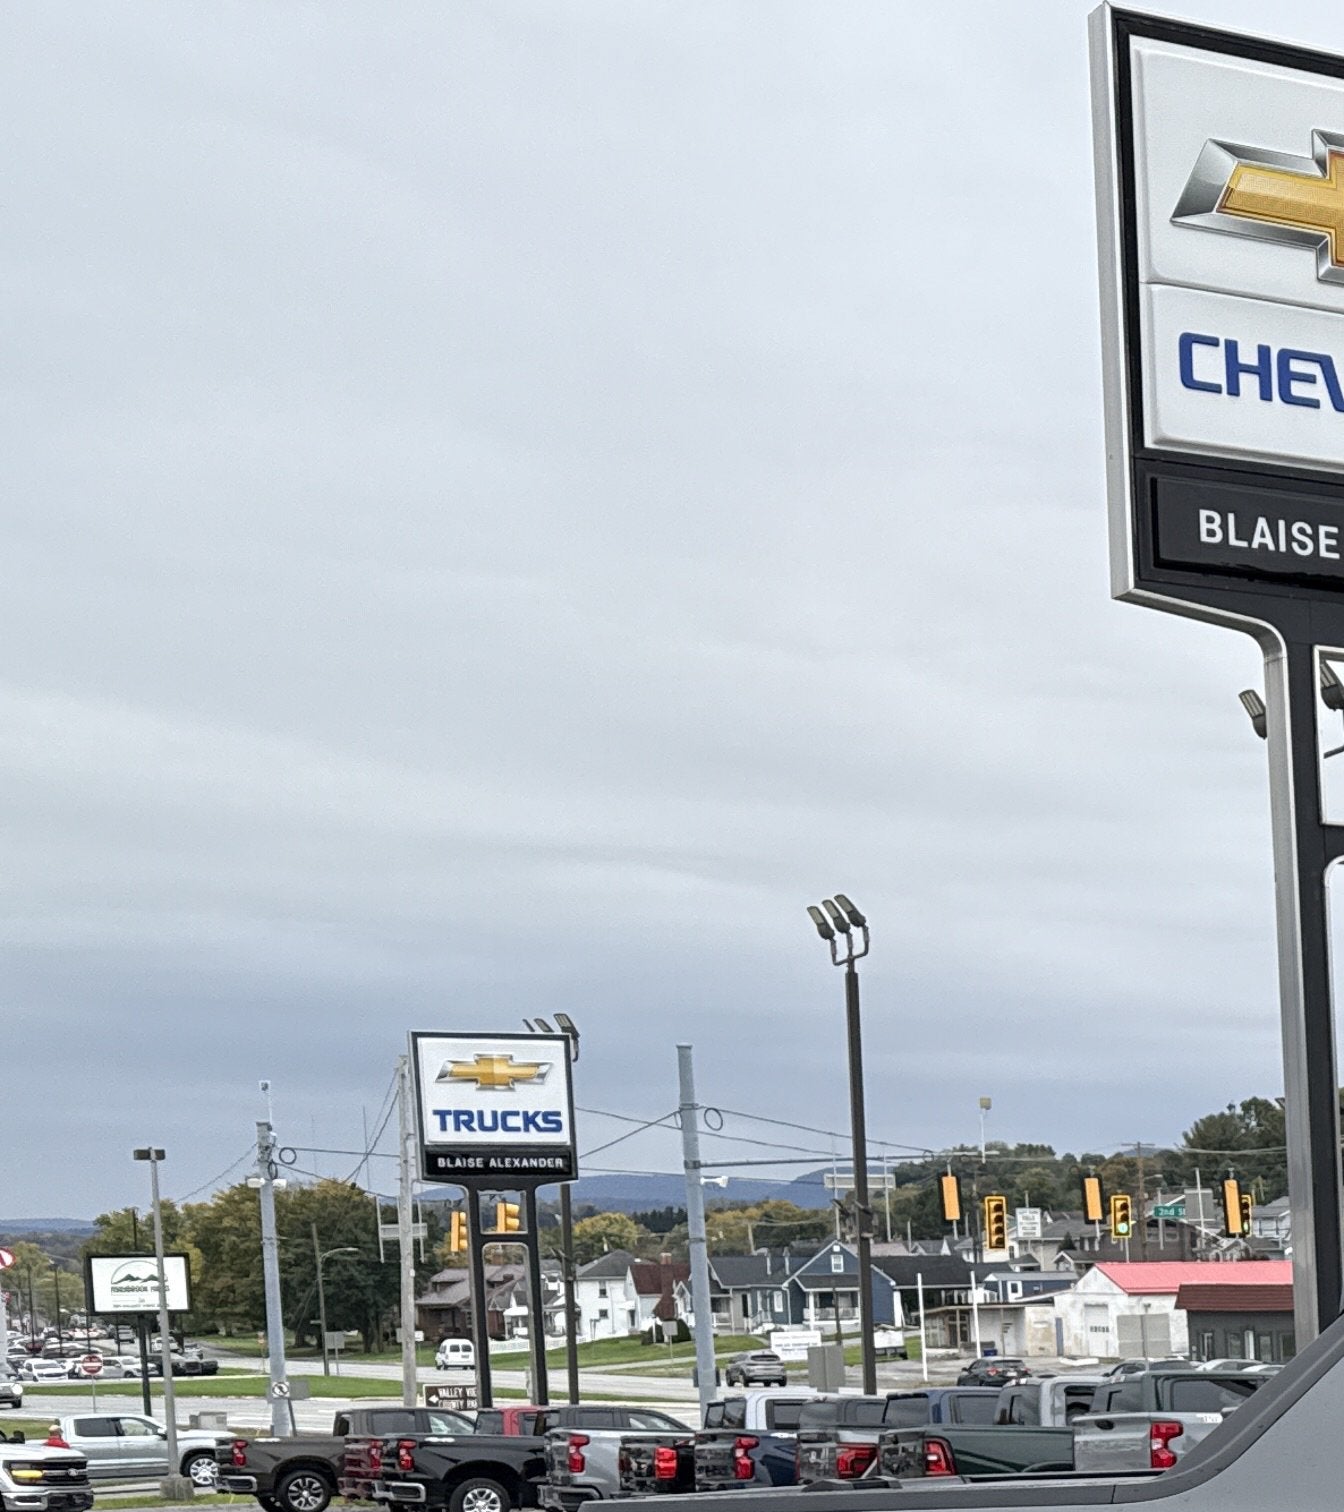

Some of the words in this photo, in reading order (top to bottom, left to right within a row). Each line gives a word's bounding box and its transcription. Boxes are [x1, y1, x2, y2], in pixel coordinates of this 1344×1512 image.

[1199, 510, 1341, 561] BLAISE
[433, 1109, 563, 1132] TRUCKS
[437, 1157, 484, 1168] BLAISE
[489, 1158, 563, 1168] ALEXANDER
[1158, 1207, 1175, 1216] 2nd
